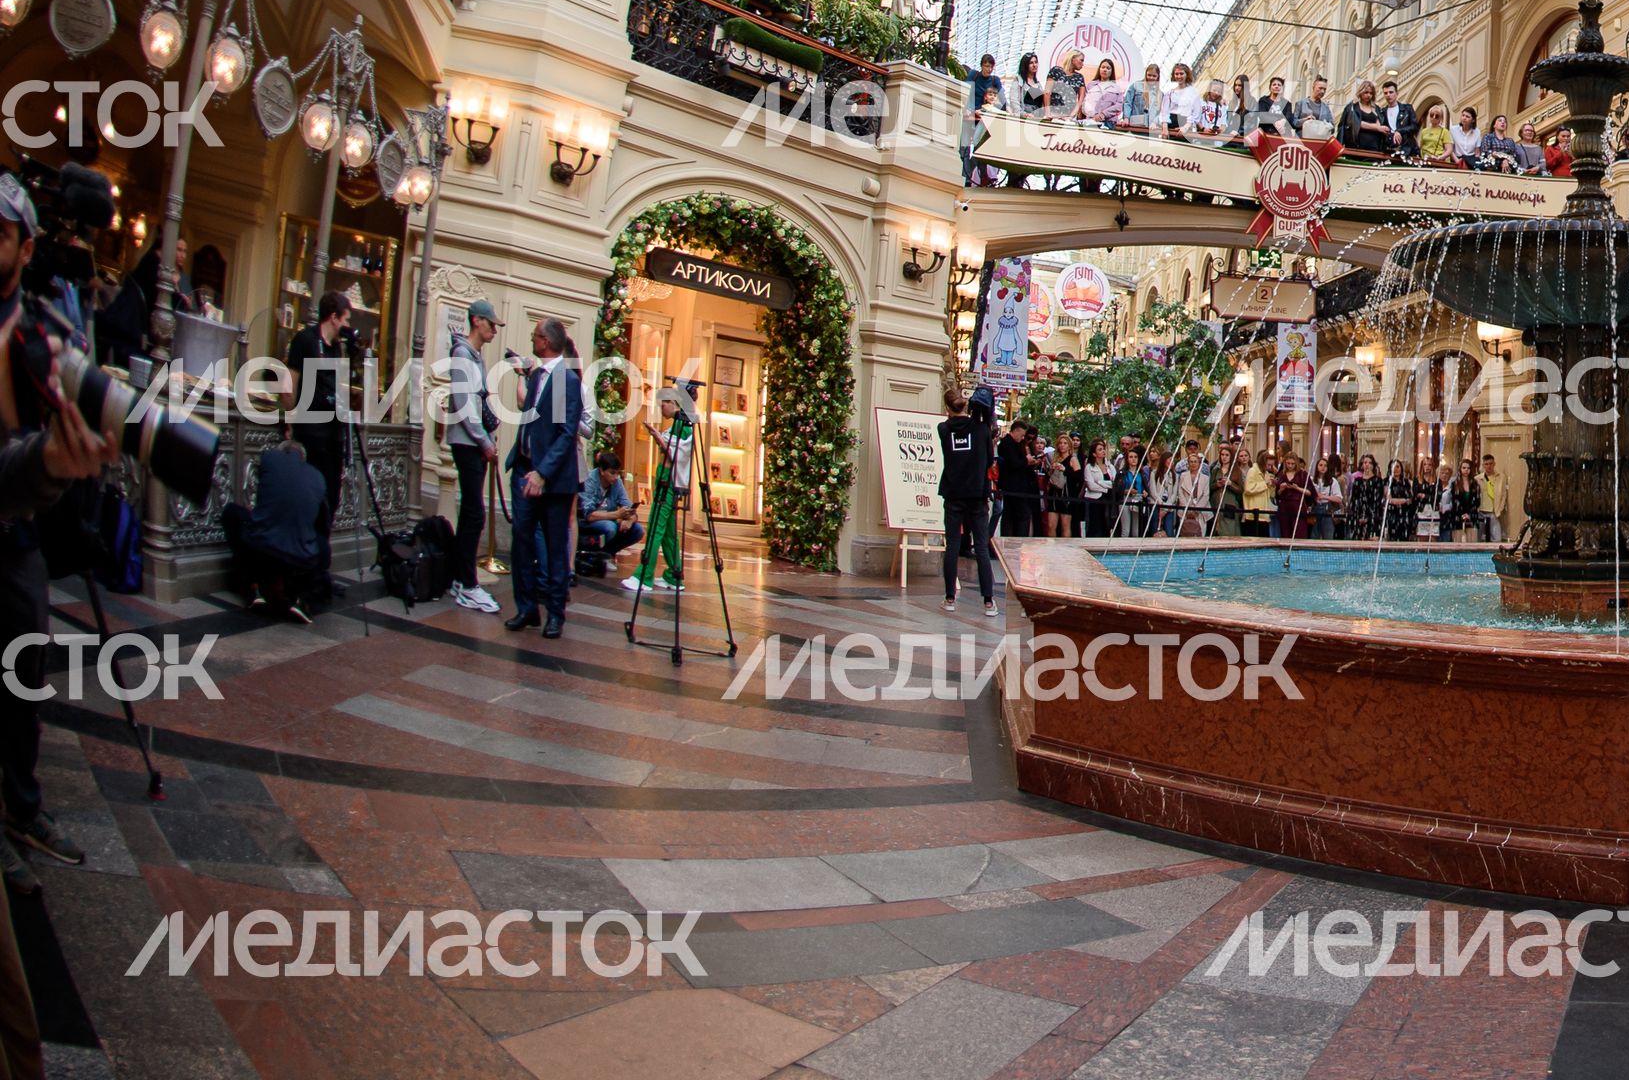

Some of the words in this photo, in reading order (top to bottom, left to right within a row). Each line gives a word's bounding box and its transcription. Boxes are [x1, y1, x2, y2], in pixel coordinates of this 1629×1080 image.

[1074, 24, 1113, 53] ГУМ
[1040, 133, 1118, 158] Главный
[1126, 149, 1203, 174] магазин
[1279, 146, 1310, 171] ГУМ
[1263, 193, 1290, 217] КРАСНАЯ
[1383, 182, 1405, 194] на
[1485, 188, 1546, 208] площади
[671, 261, 772, 298] АРТИКОЛИ
[1074, 266, 1094, 281] ГУМ
[1260, 289, 1268, 300] 2
[1271, 306, 1288, 315] LINE
[898, 441, 935, 463] SS22
[901, 470, 938, 485] 20.06.22
[915, 494, 931, 507] ГУМ
